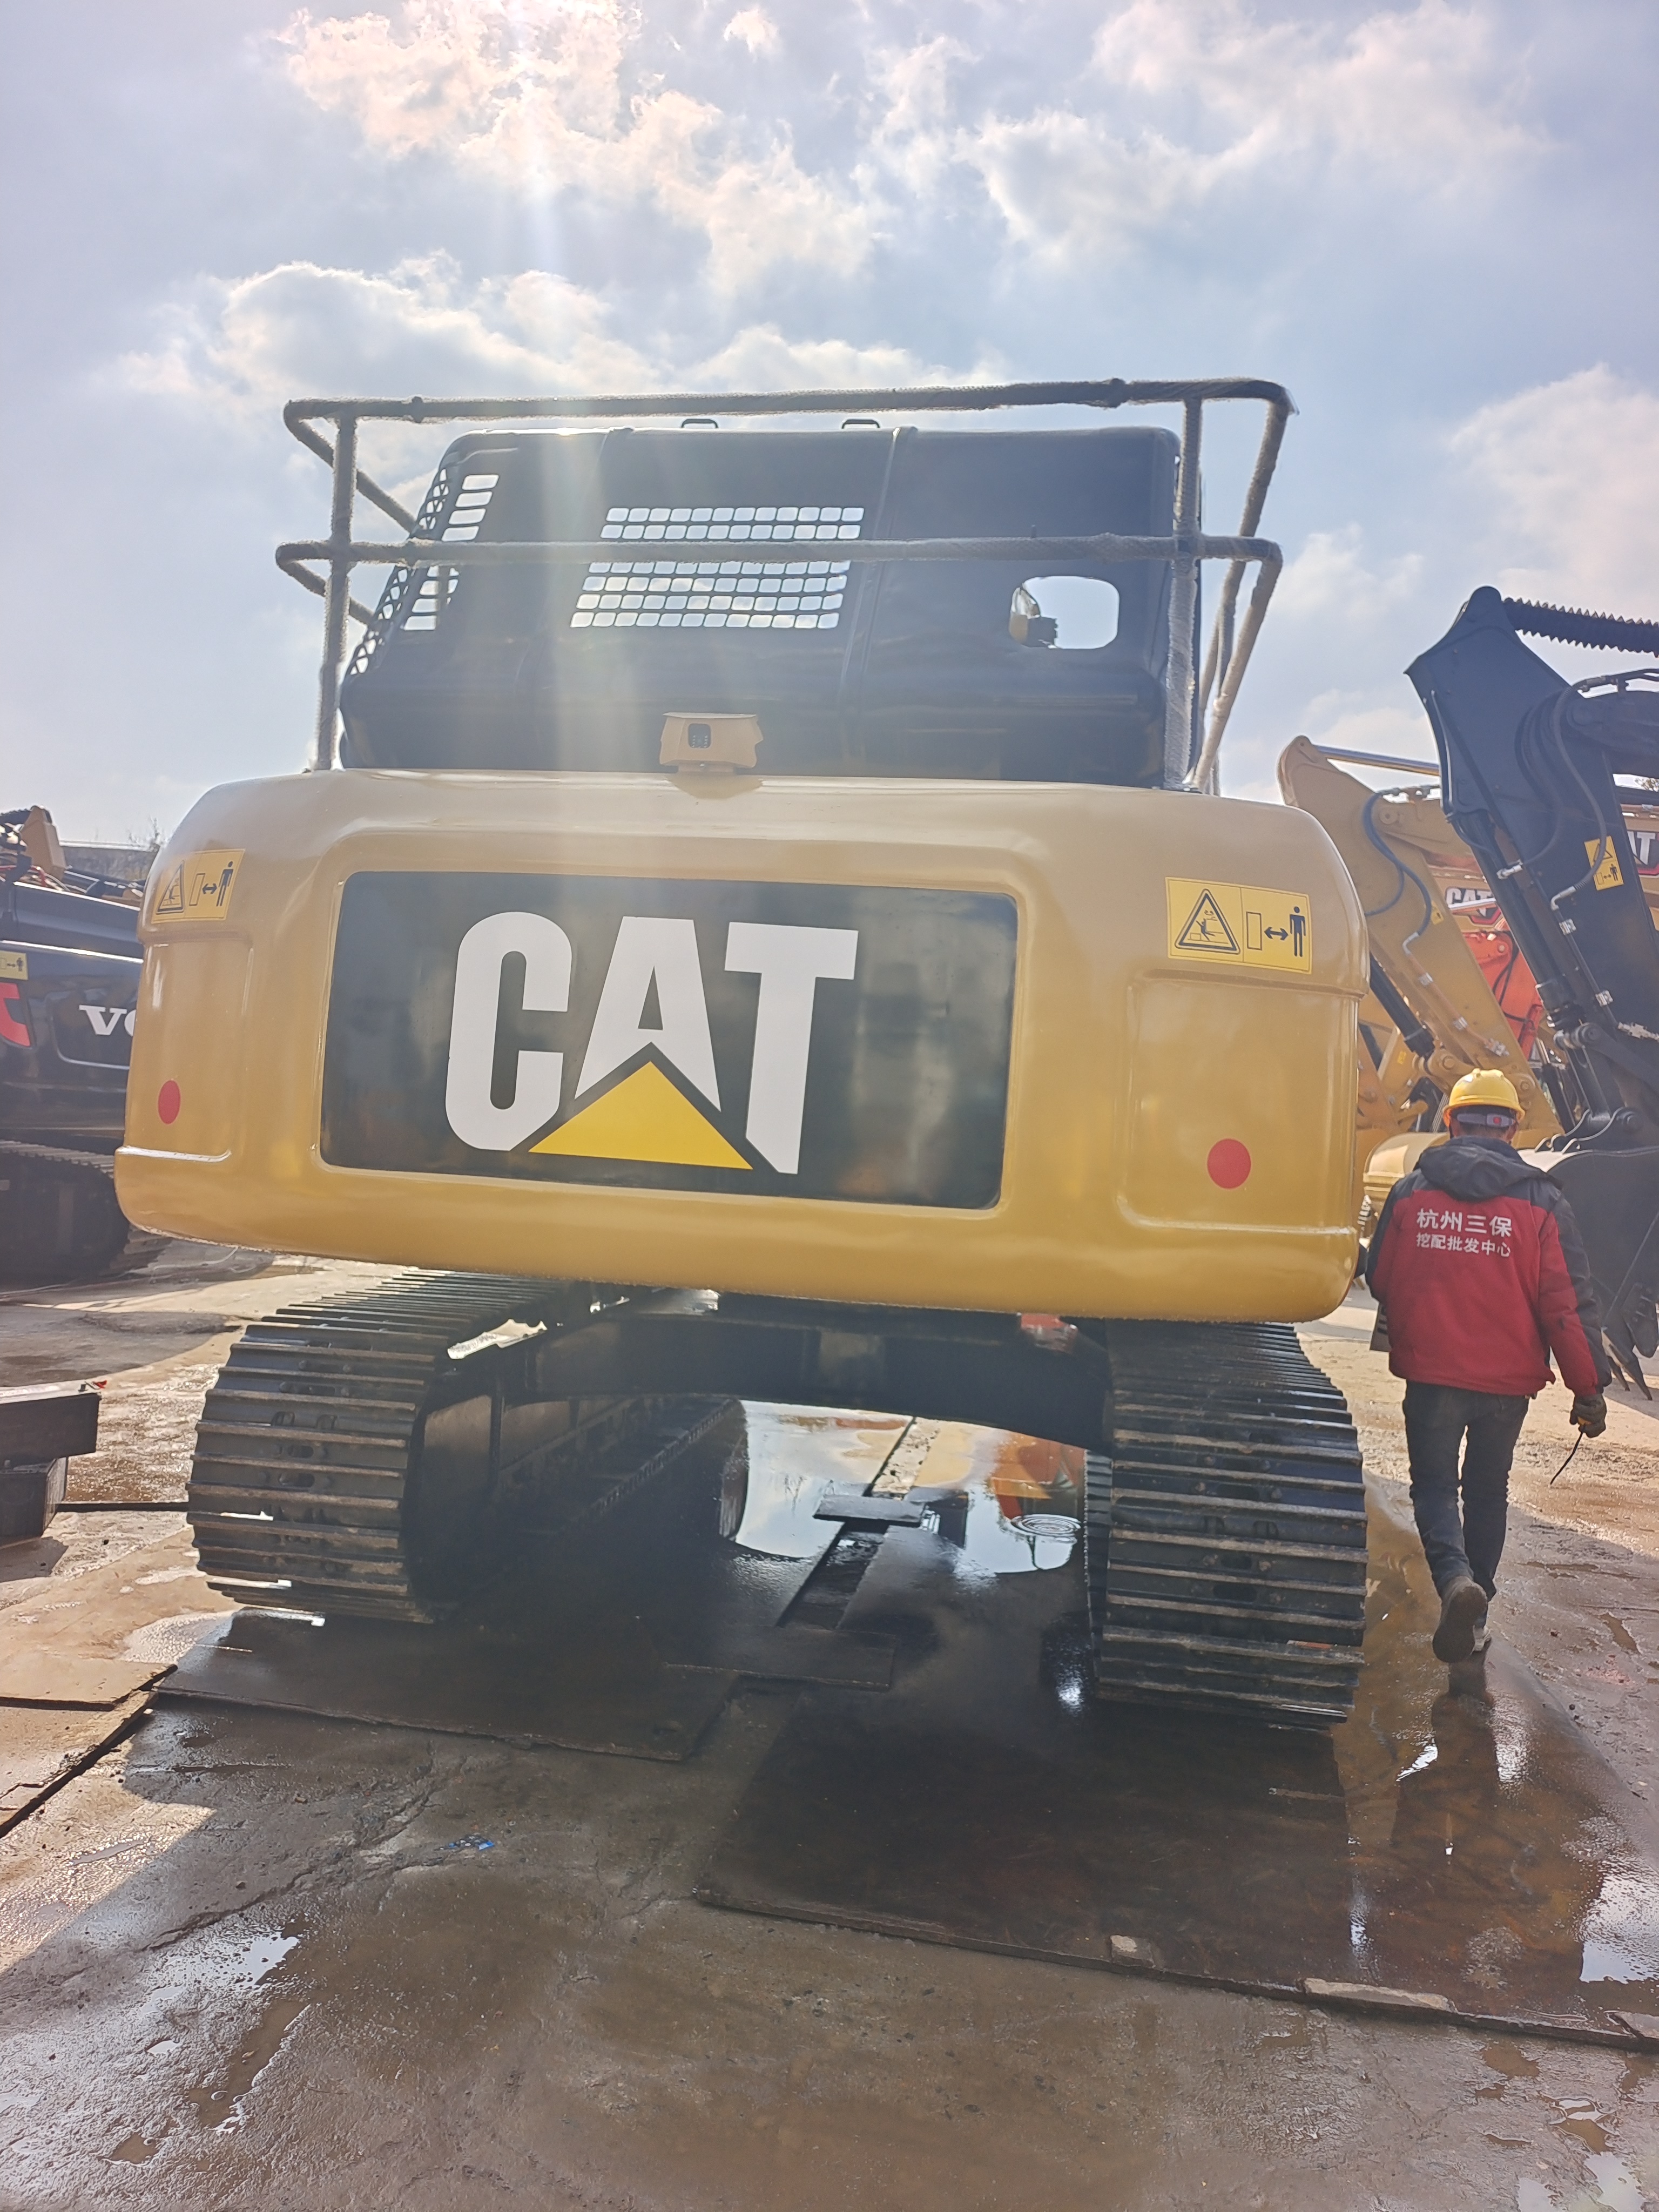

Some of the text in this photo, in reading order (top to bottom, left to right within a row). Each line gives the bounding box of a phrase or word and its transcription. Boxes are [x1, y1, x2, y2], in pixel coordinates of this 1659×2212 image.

[445, 911, 859, 1175] CAT
[1417, 1208, 1512, 1237] 杭州三保
[1416, 1232, 1511, 1258] 挖配批发中心
